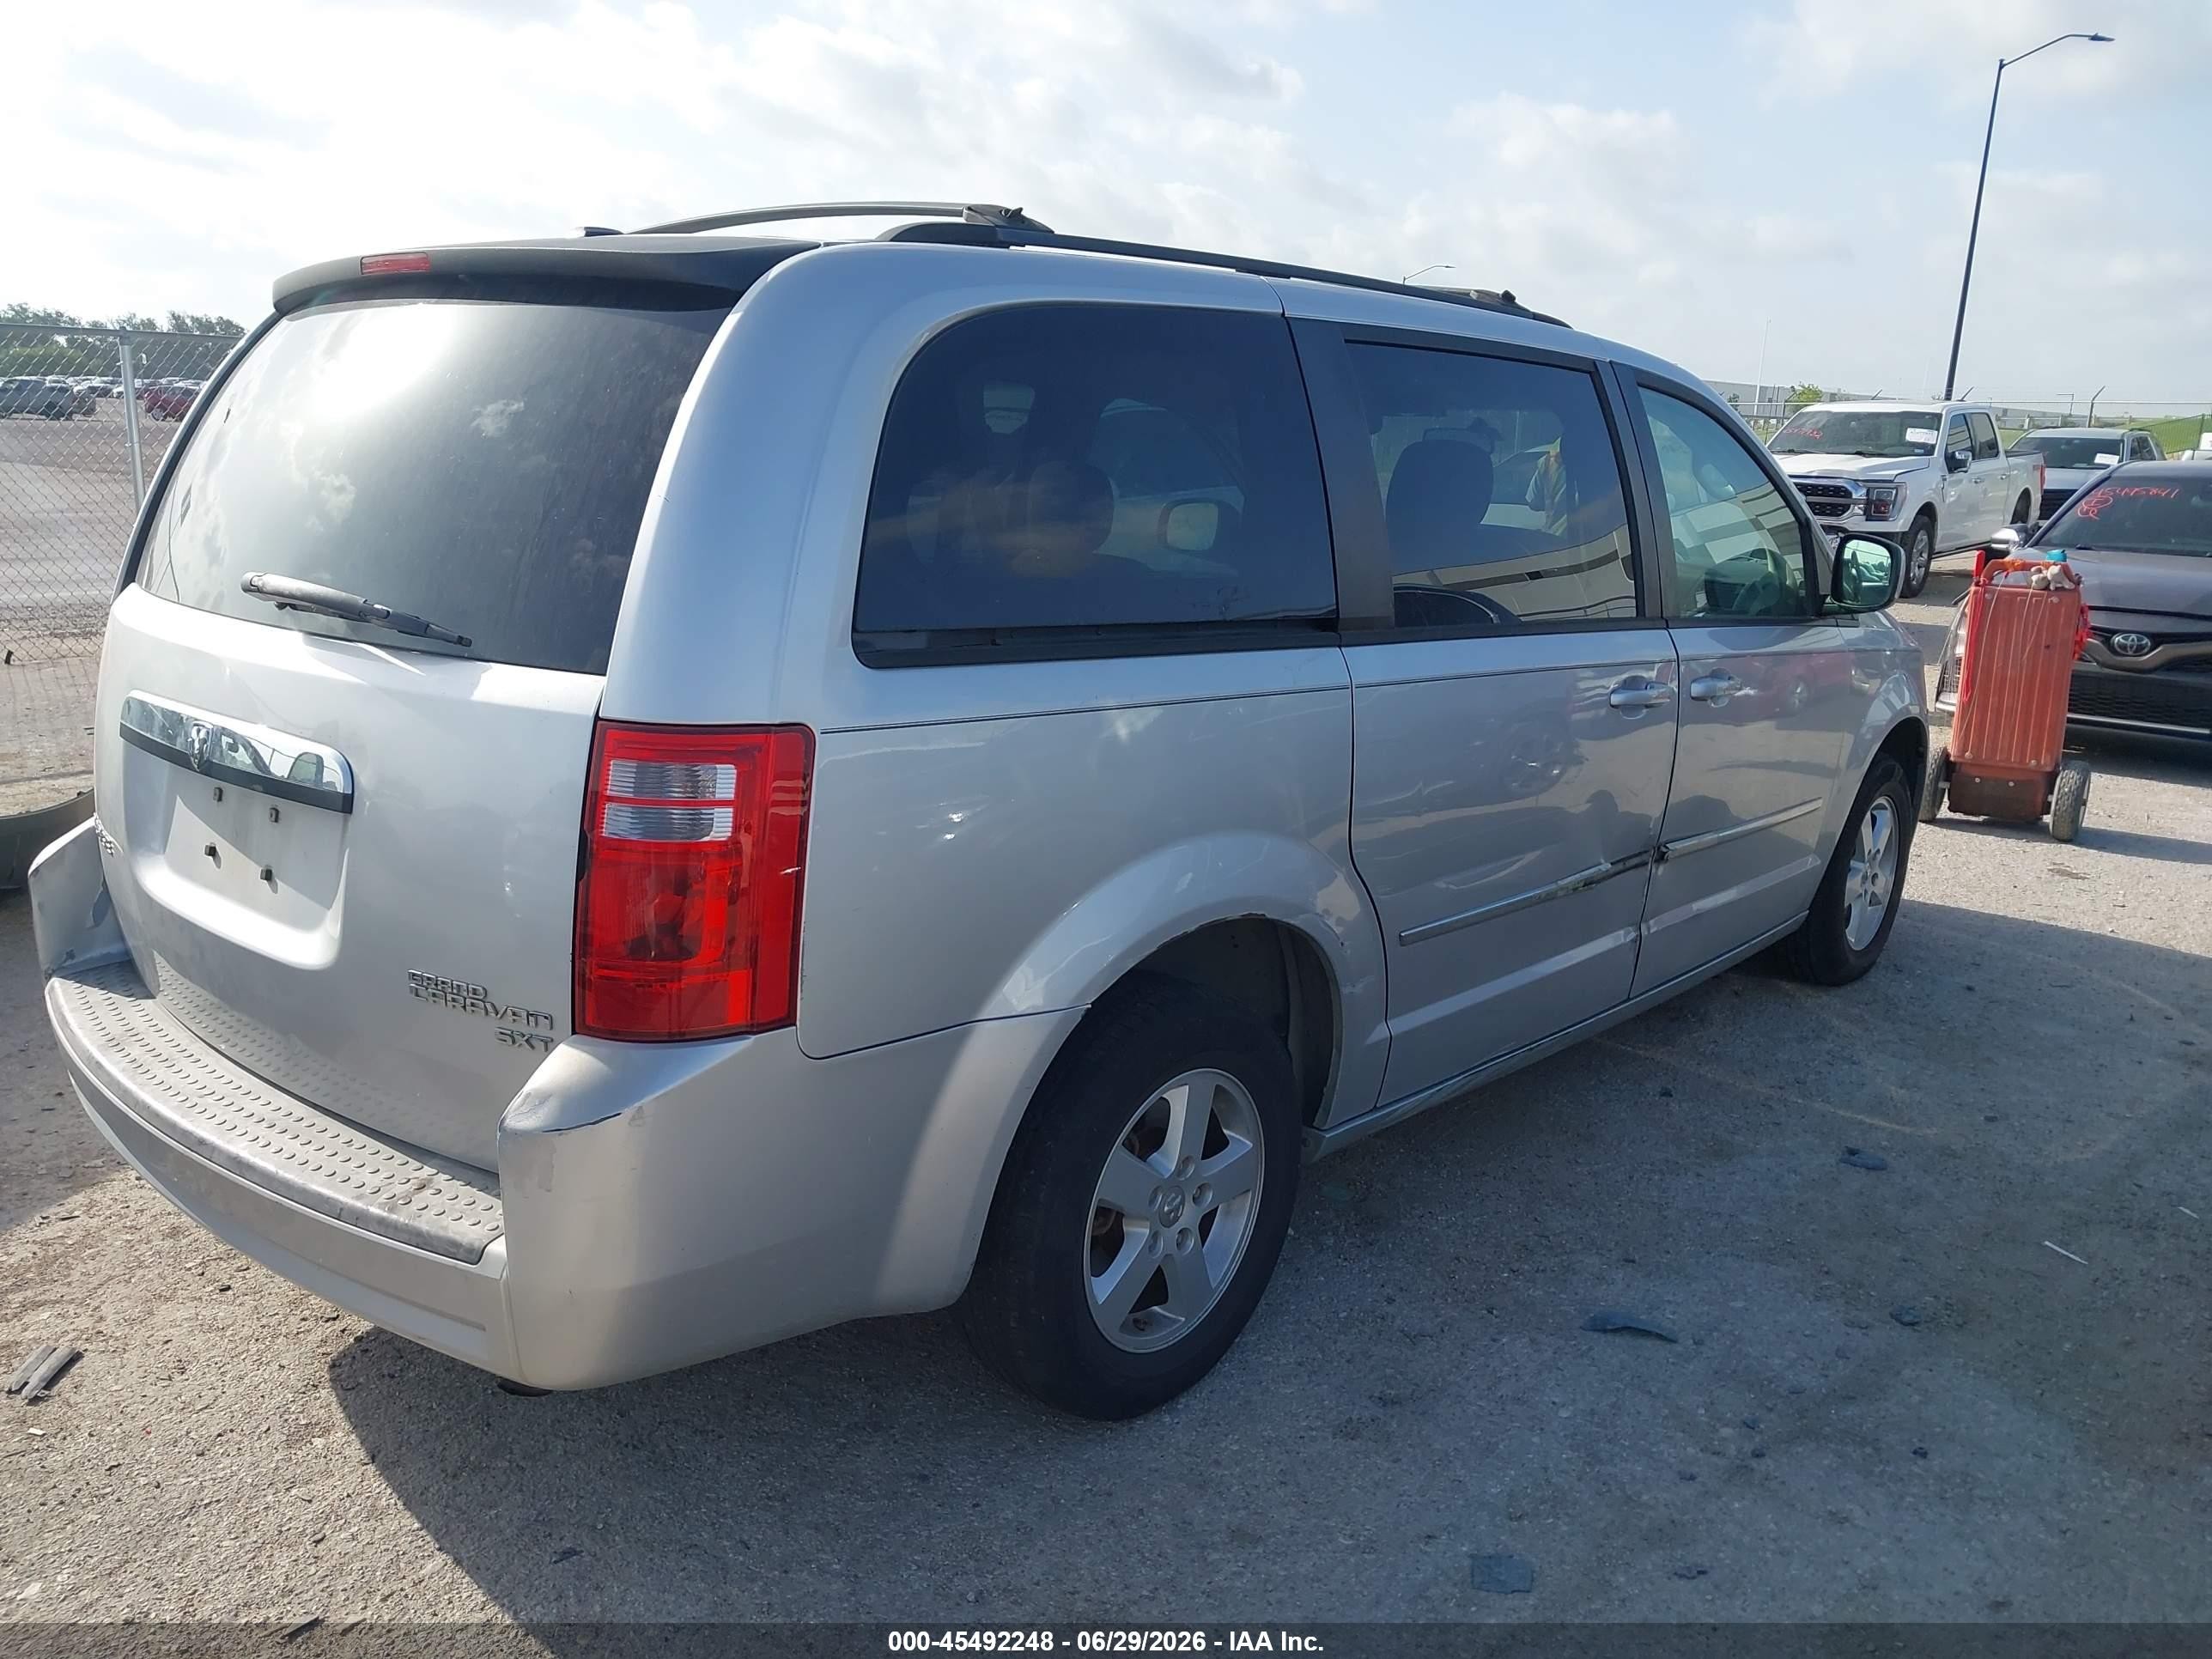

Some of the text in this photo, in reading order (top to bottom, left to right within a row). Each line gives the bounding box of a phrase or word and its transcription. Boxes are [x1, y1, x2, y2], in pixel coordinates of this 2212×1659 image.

[407, 969, 488, 1000] GRAND
[409, 983, 554, 1030] CARAVAN
[494, 1026, 554, 1053] SXT
